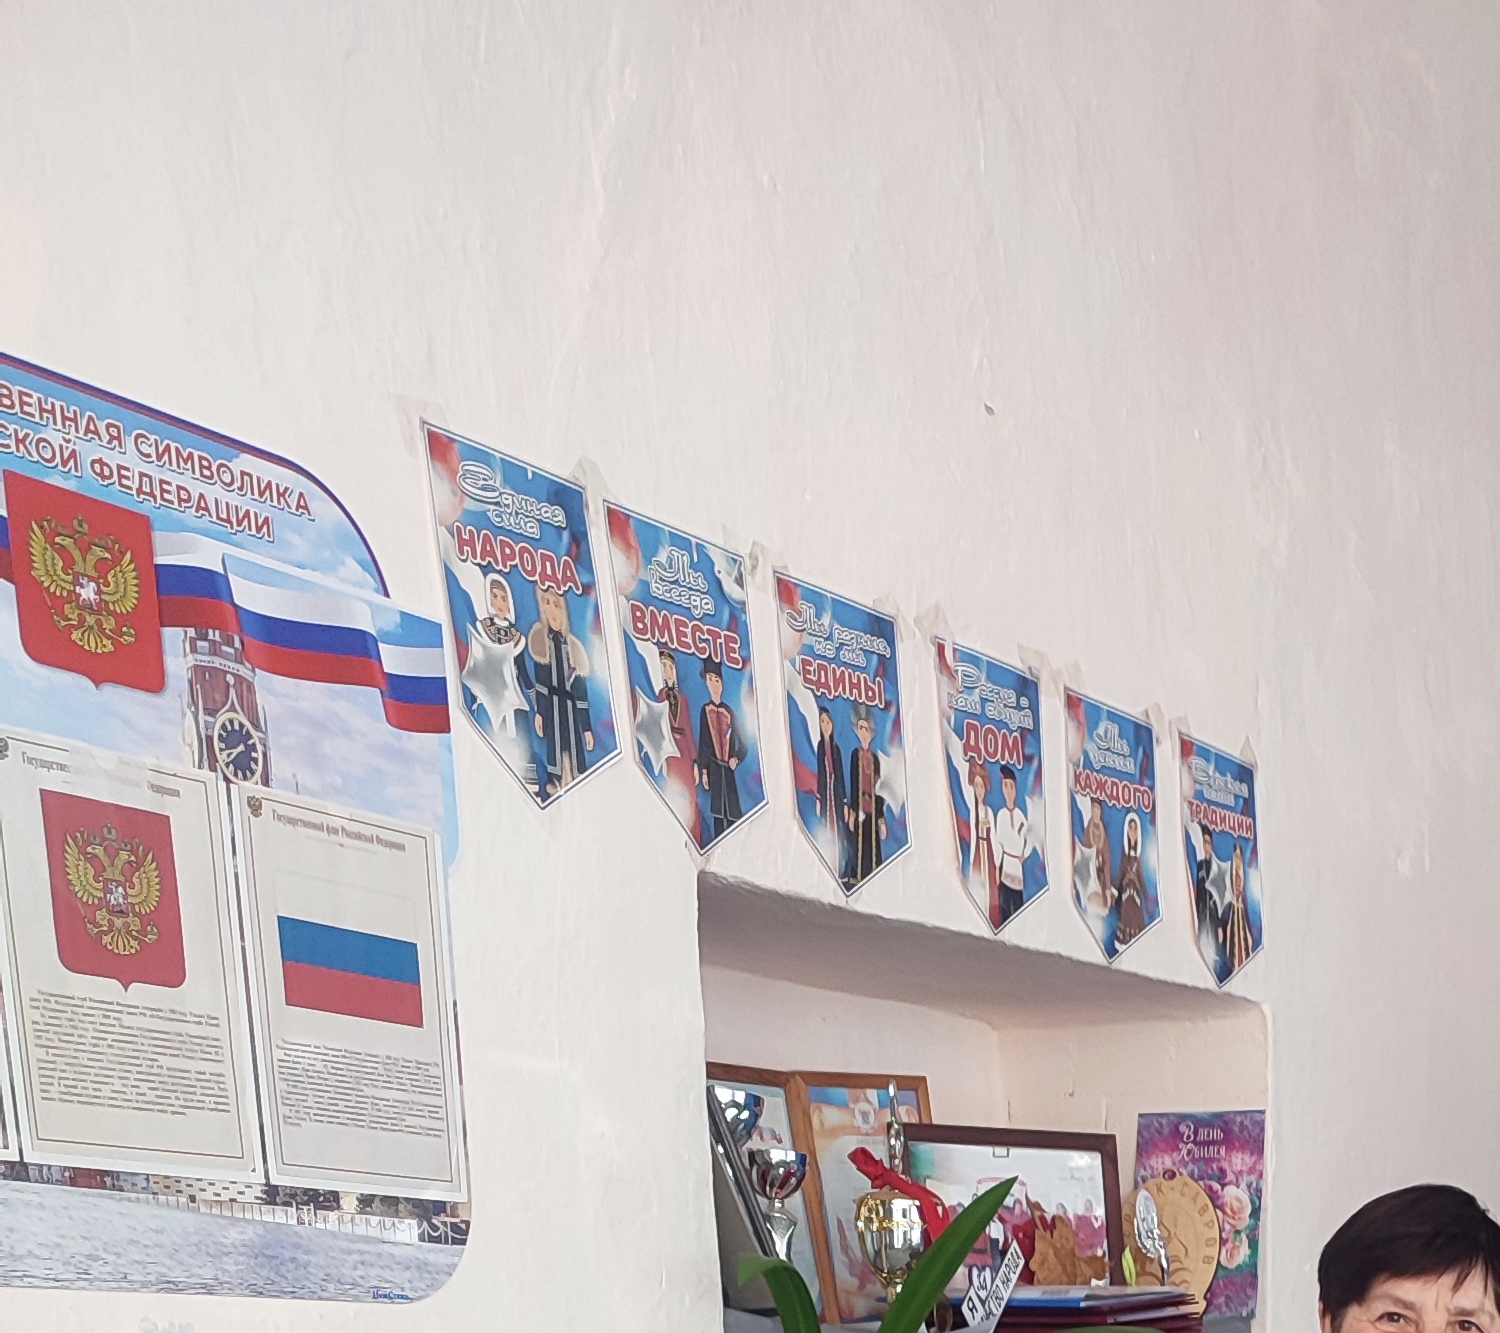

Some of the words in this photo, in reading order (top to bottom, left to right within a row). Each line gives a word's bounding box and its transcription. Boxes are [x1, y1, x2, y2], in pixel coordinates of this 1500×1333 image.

[89, 456, 274, 540] ФЕДЕРАЦИИ
[133, 431, 313, 518] СИМВОЛИКА
[458, 461, 566, 528] Единая
[454, 522, 582, 594] НАРОДА
[629, 600, 742, 668] ВМЕСТЕ
[800, 655, 884, 708] ЕДИНЫ
[962, 719, 1023, 769] ДОМ
[1074, 766, 1152, 813] КАЖДОГО
[1186, 799, 1254, 840] ТРАДИЦИИ
[1179, 1121, 1194, 1142] В
[999, 1246, 1022, 1294] НАРОДА
